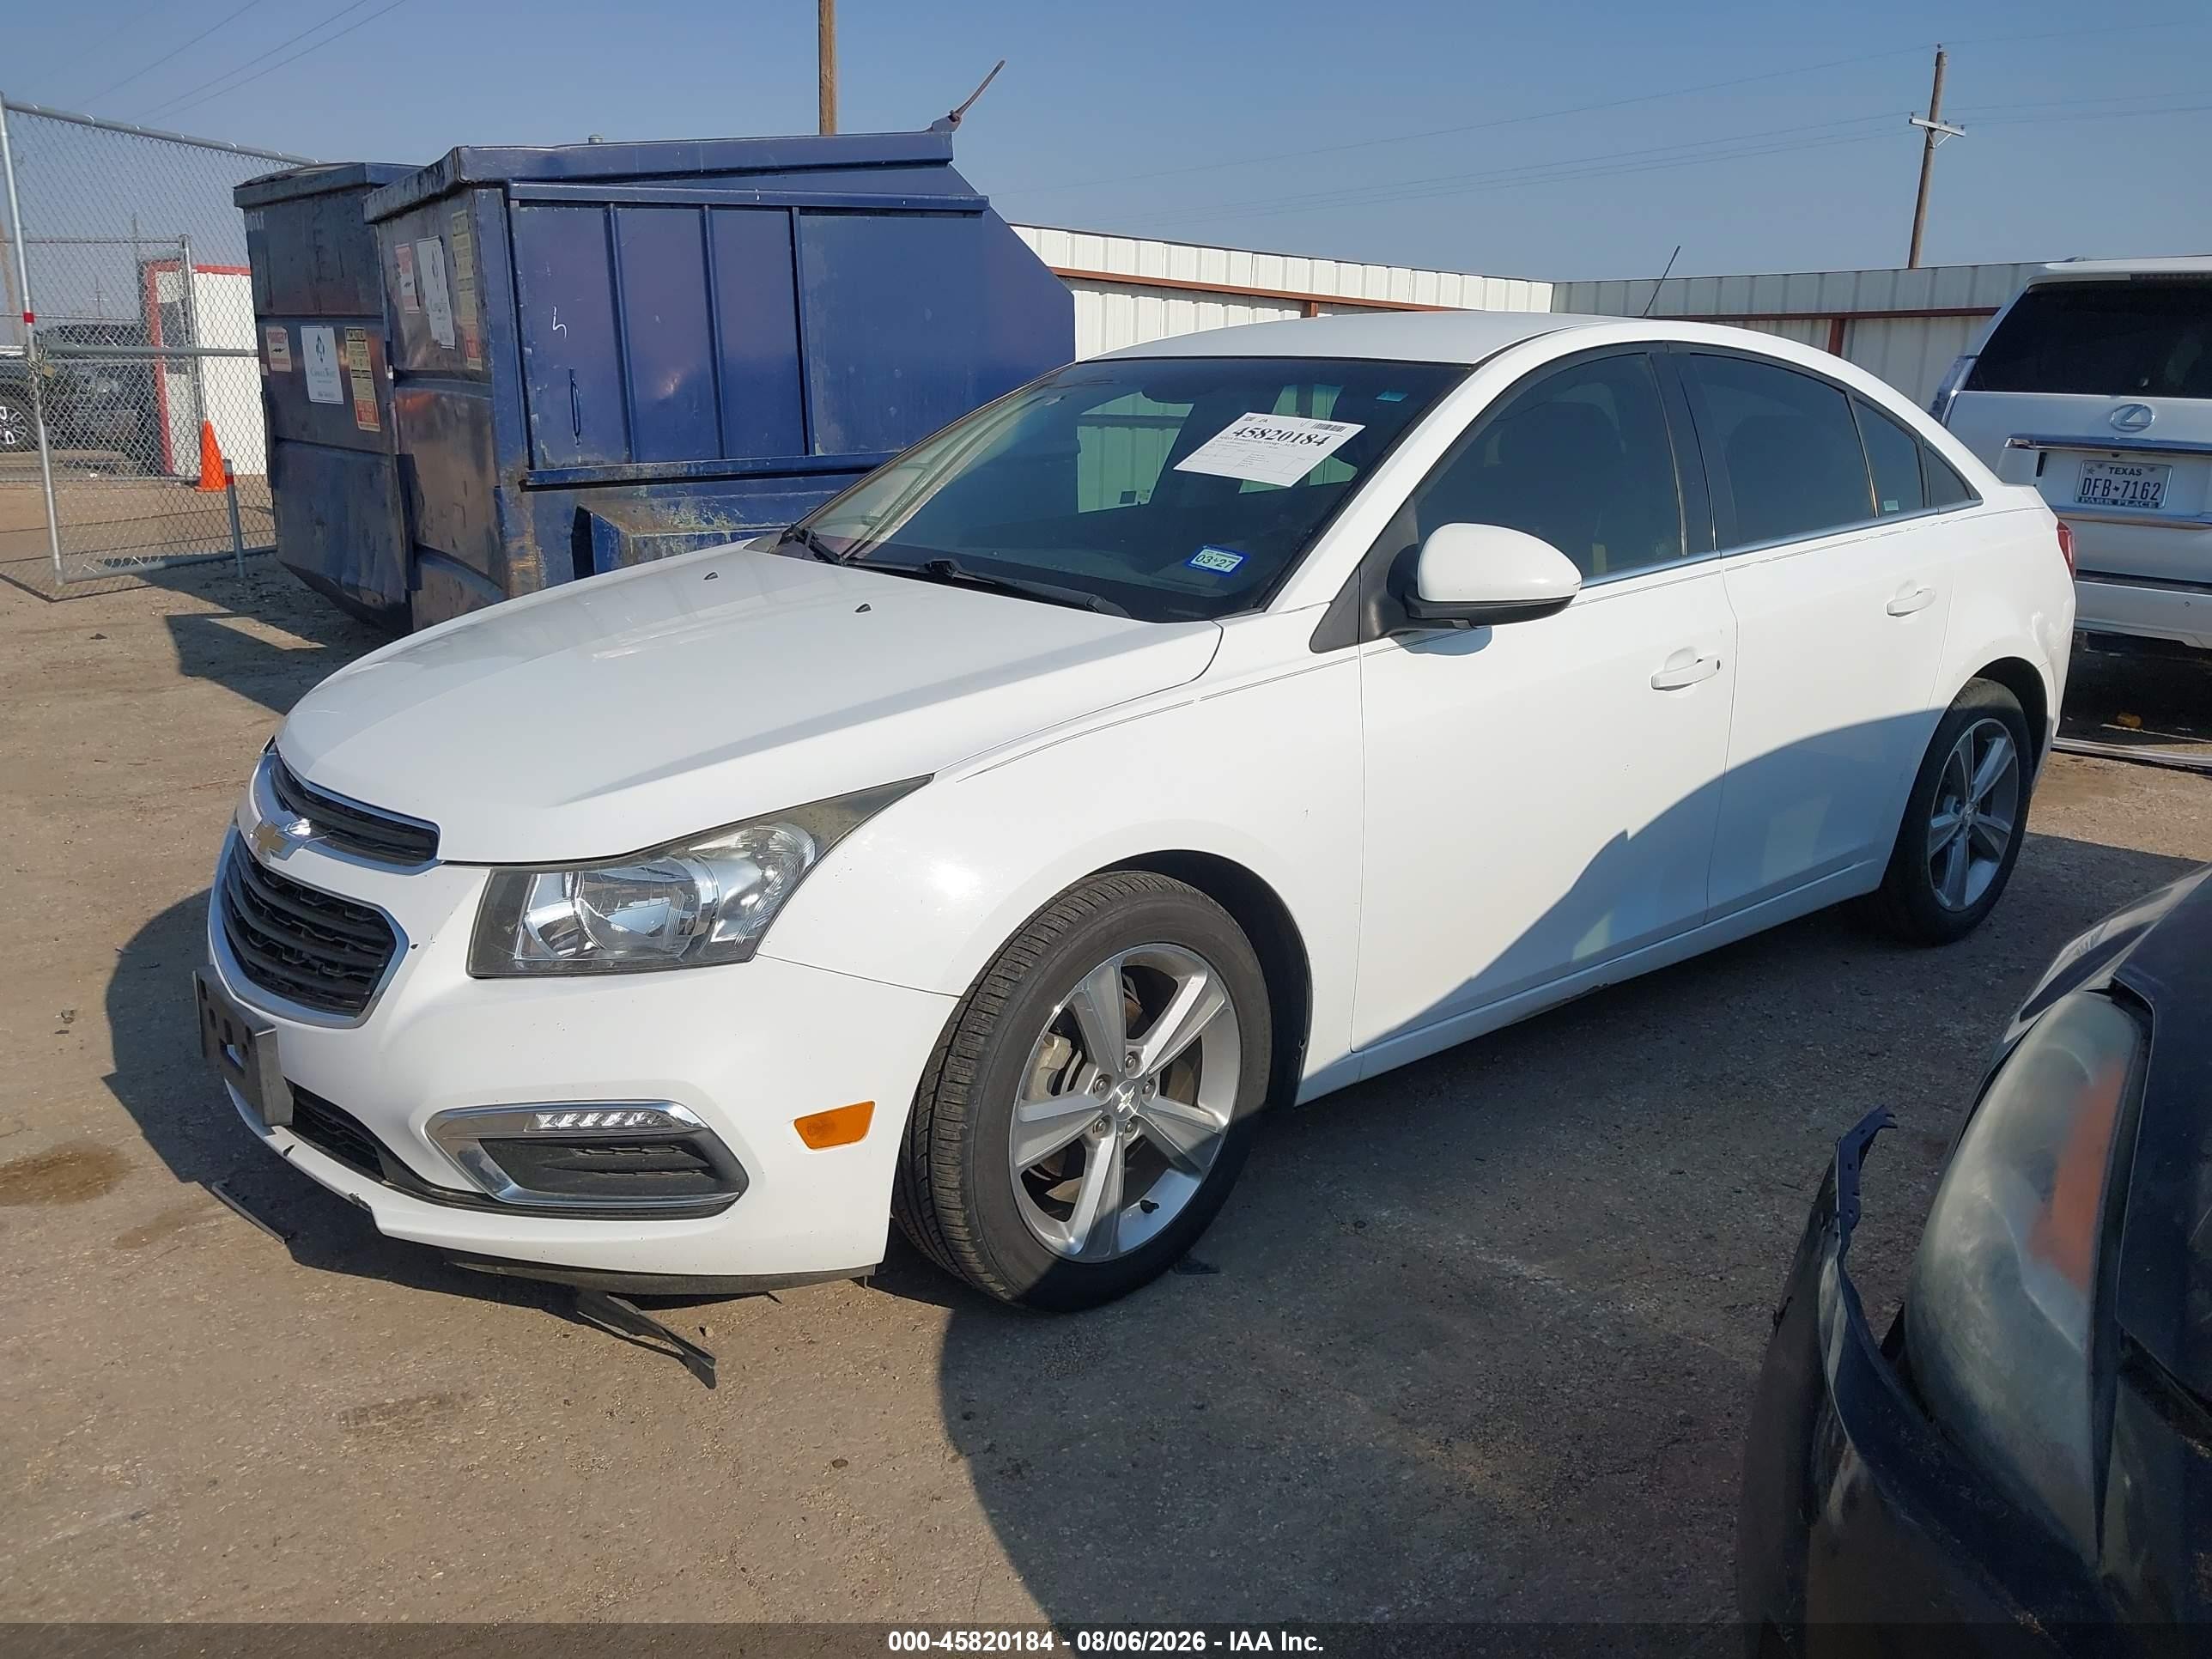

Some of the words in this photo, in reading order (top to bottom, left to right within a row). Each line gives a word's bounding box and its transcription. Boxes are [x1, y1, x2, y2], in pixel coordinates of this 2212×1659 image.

[1232, 426, 1333, 447] 45820184
[2109, 466, 2142, 477] TEXAS
[2081, 477, 2112, 497] DFB
[2121, 480, 2161, 501] 7162
[2080, 496, 2114, 505] PARK
[2118, 499, 2159, 508] PLACE
[1195, 554, 1213, 564] 03
[1215, 558, 1237, 569] 27
